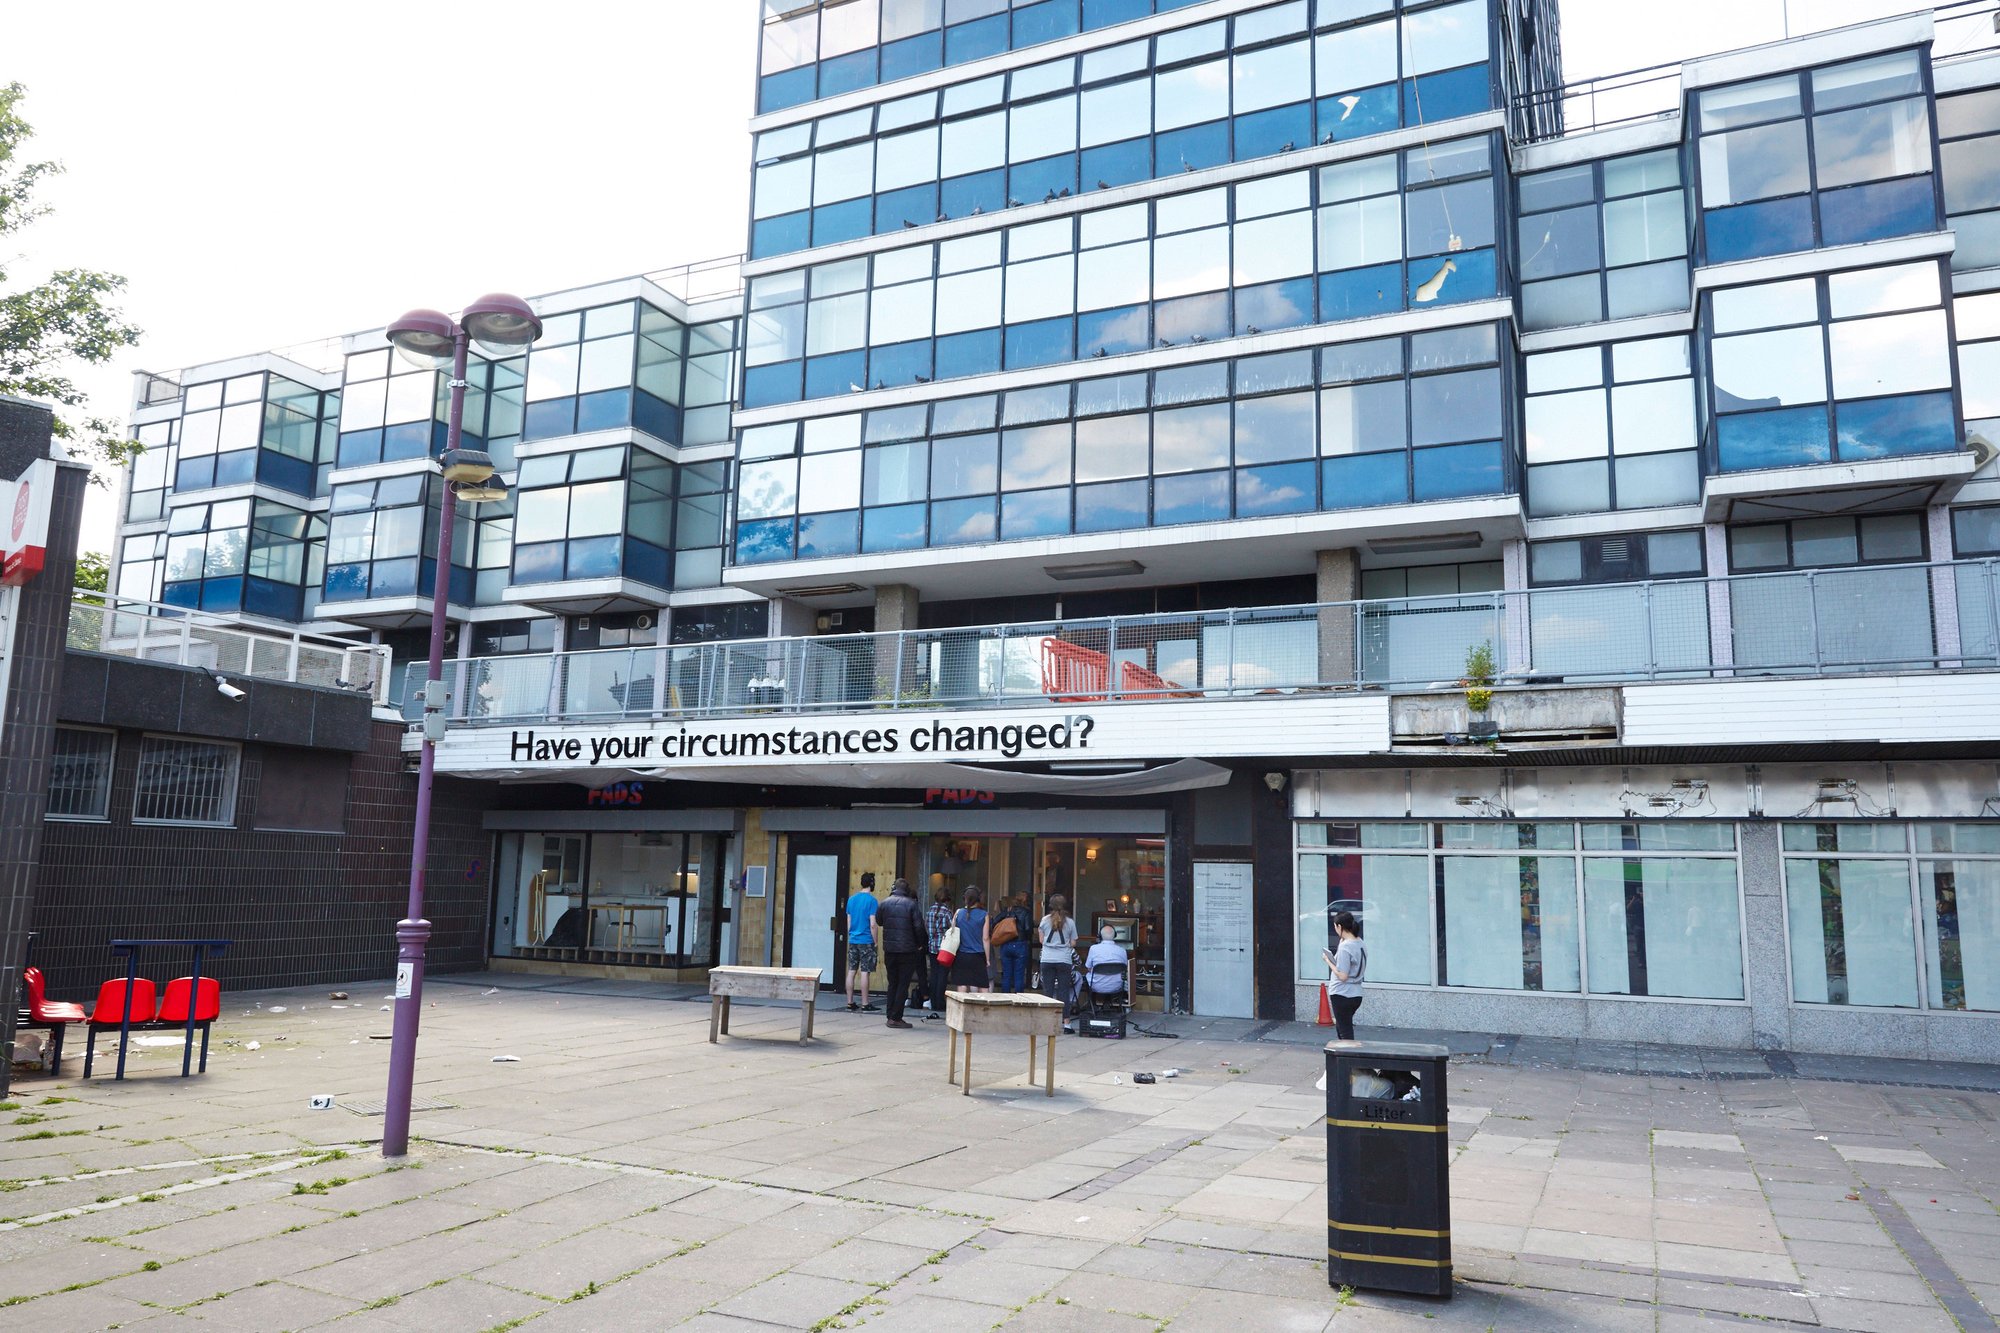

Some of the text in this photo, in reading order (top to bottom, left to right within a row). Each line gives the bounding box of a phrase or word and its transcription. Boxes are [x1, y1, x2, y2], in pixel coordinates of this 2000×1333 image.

[510, 714, 1095, 765] Have your circumstances changed?
[1365, 1105, 1406, 1120] Litter
